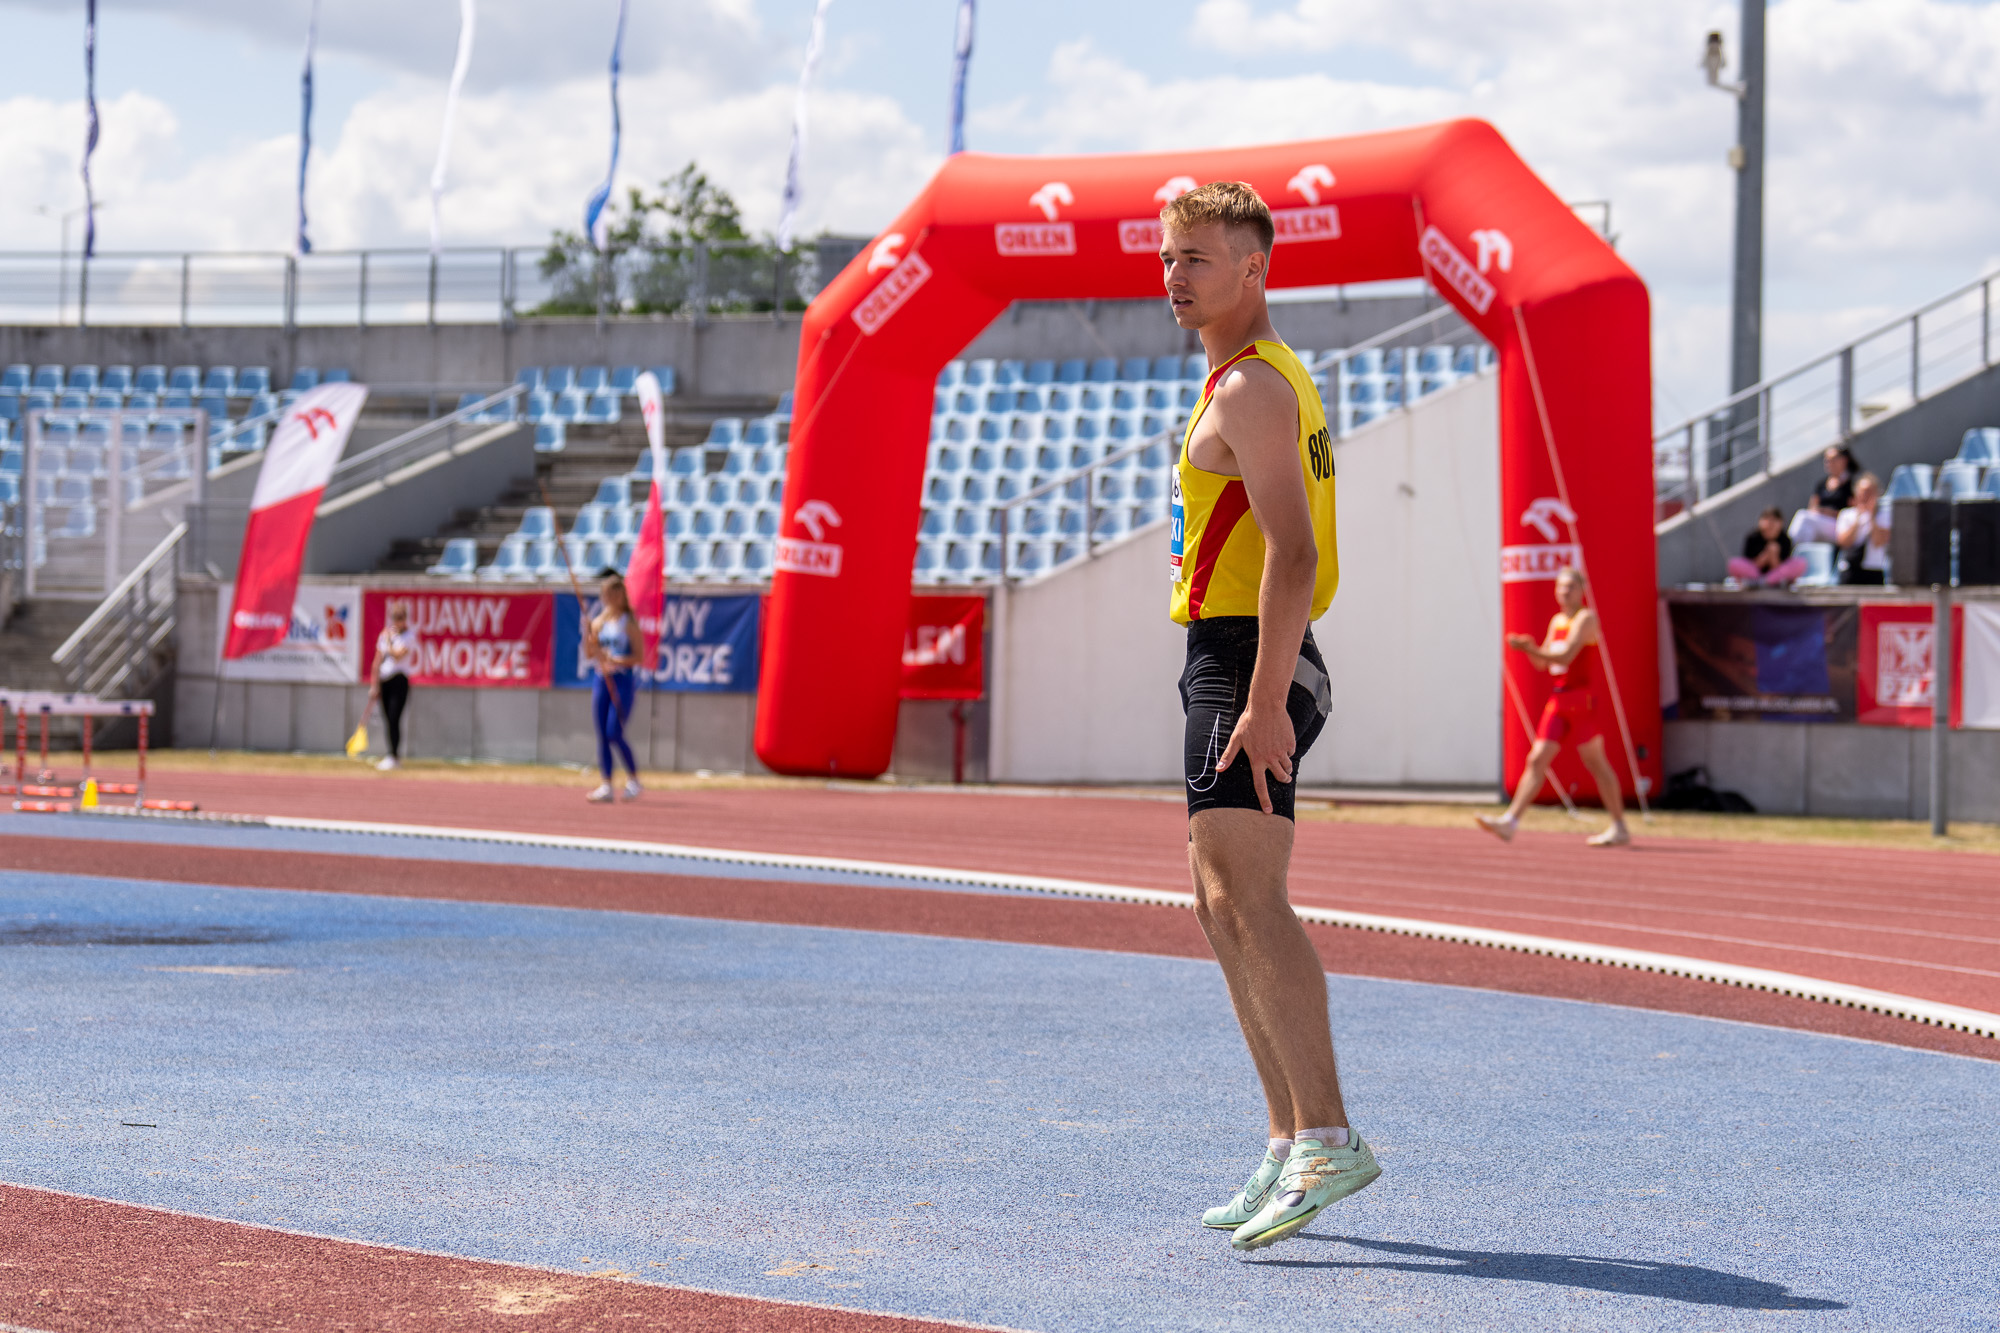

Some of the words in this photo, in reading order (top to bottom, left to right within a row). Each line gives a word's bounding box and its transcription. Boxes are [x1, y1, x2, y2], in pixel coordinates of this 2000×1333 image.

[1002, 229, 1068, 250] ORLEN
[1273, 212, 1332, 235] RLEN
[1426, 236, 1487, 306] ORLEN
[861, 261, 921, 326] ORLEN
[408, 638, 530, 679] OMORZE
[902, 624, 966, 666] LEN
